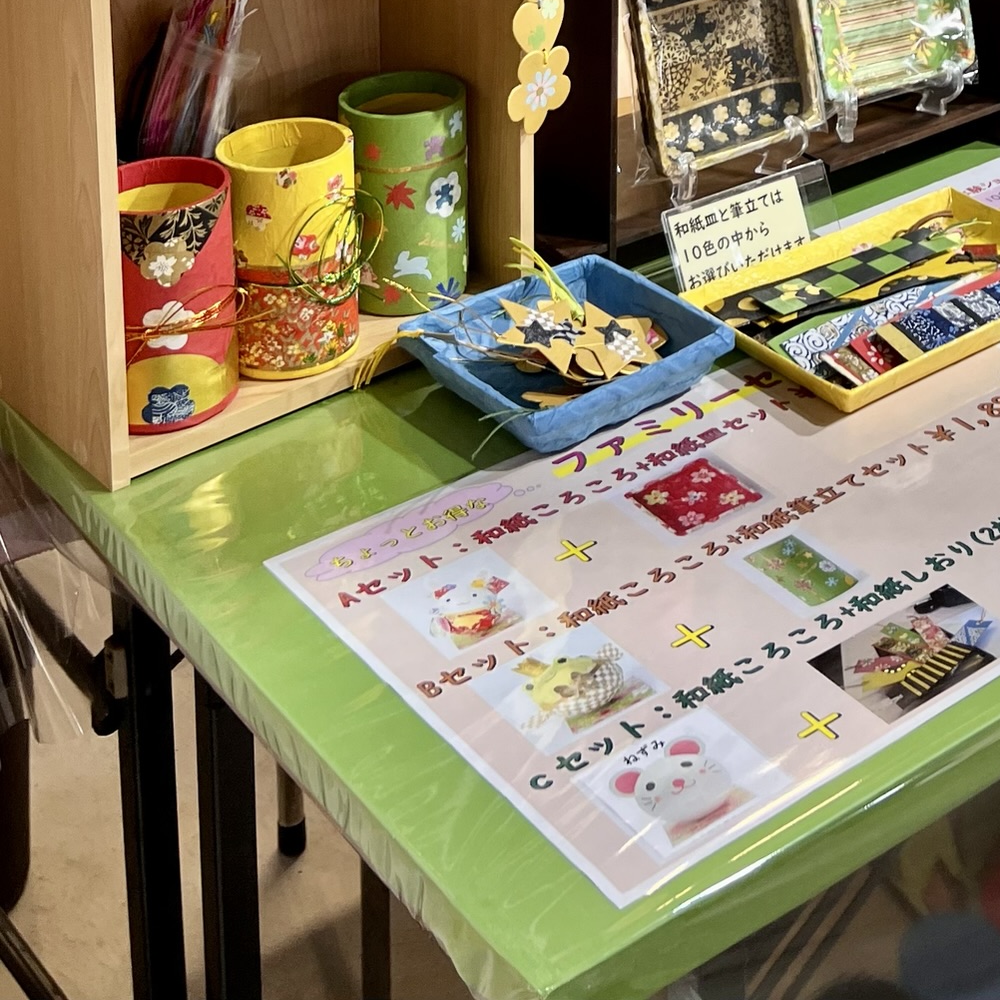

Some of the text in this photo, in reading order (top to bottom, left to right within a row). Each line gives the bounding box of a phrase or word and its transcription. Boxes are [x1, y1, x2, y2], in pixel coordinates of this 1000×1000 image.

[674, 188, 784, 239] 和紙皿と筆立ては
[683, 221, 771, 264] 10色の中から
[326, 495, 489, 571] ちょっとお得な
[623, 739, 666, 767] ねずみ
